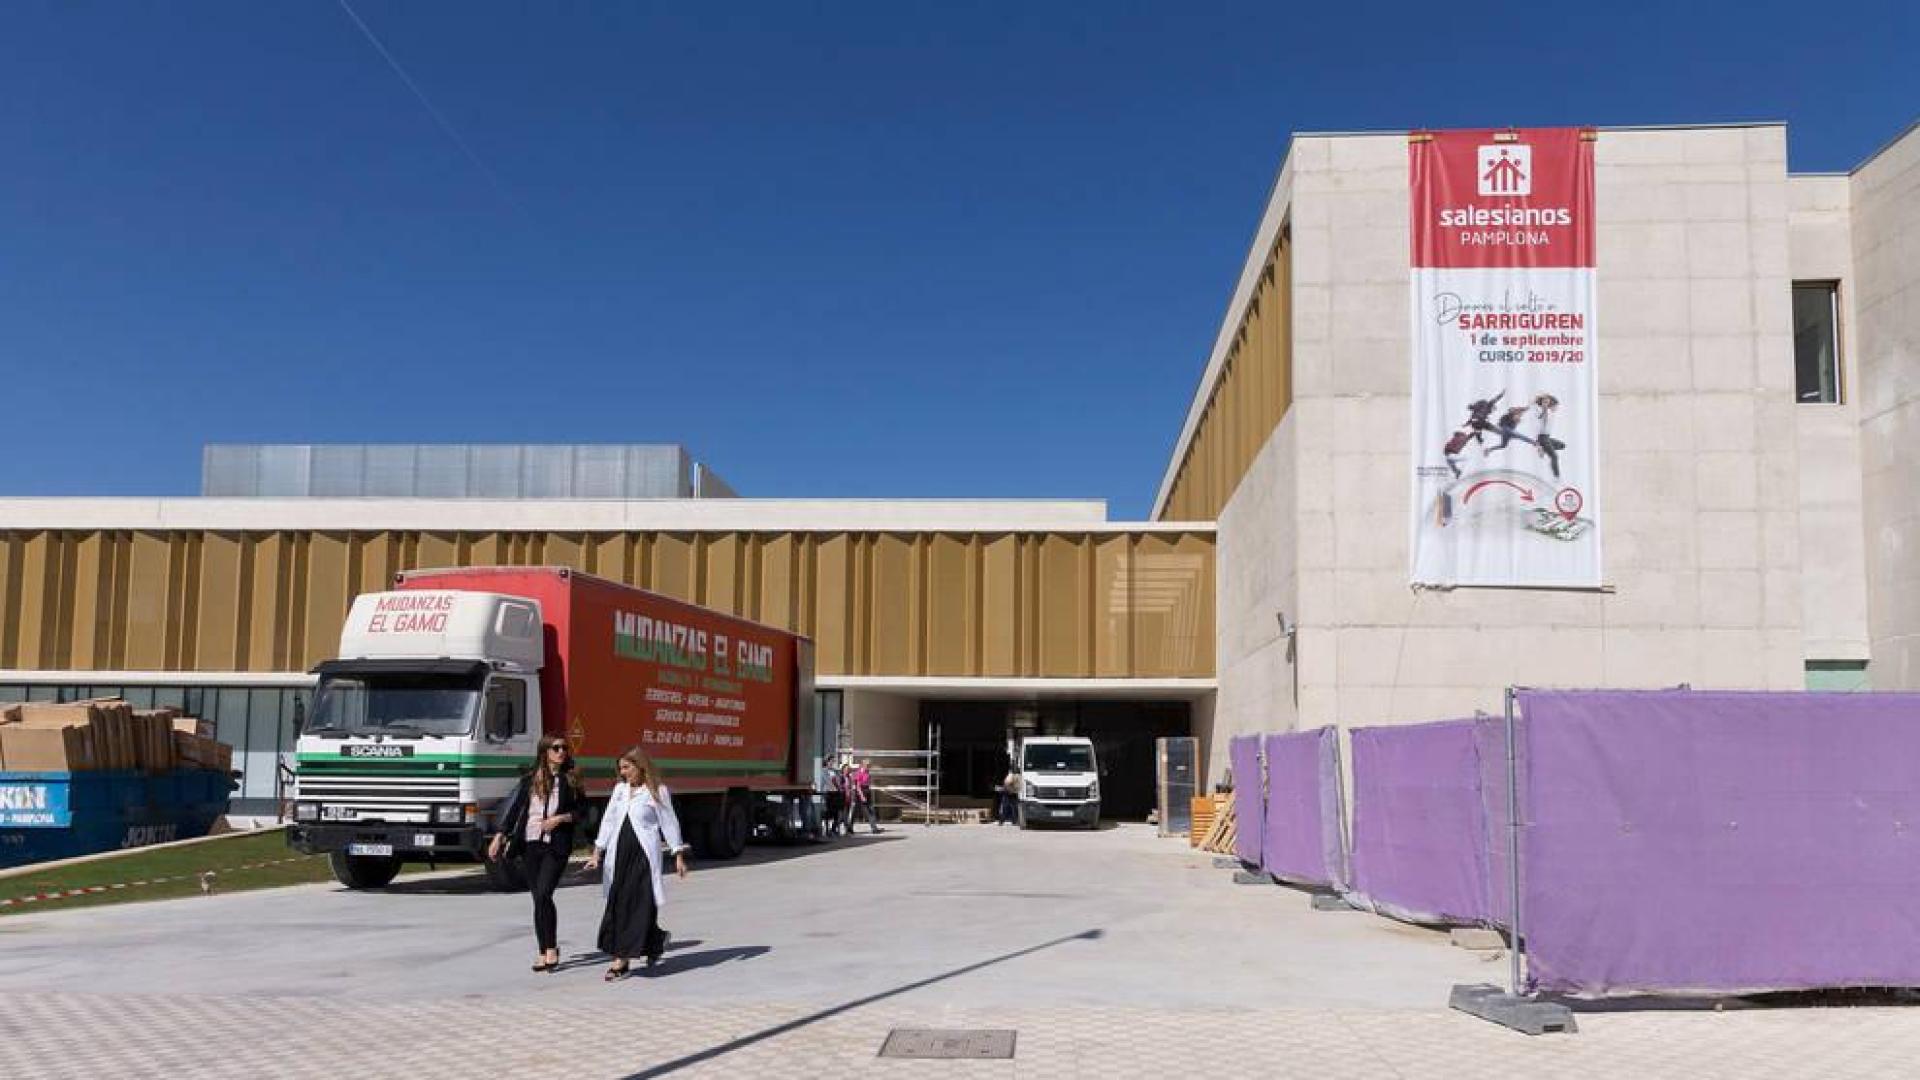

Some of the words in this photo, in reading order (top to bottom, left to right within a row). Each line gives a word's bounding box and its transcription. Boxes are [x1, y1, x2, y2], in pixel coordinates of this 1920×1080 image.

[1439, 204, 1572, 227] salesianos
[1461, 232, 1550, 246] PAMPLONA
[1458, 313, 1584, 330] SARRIGUREN
[1470, 333, 1477, 346] 1
[1481, 333, 1498, 346] de
[1502, 333, 1584, 350] septiembre
[1479, 350, 1525, 363] CURSO
[1527, 350, 1584, 363] 2019/20
[375, 595, 453, 613] MUDANZAS
[367, 614, 387, 633] EL
[393, 614, 448, 633] GAMO
[614, 609, 707, 671] MUDANZAS
[712, 633, 730, 676] EL
[736, 639, 774, 684] GAMO
[350, 745, 403, 757] SCANIA
